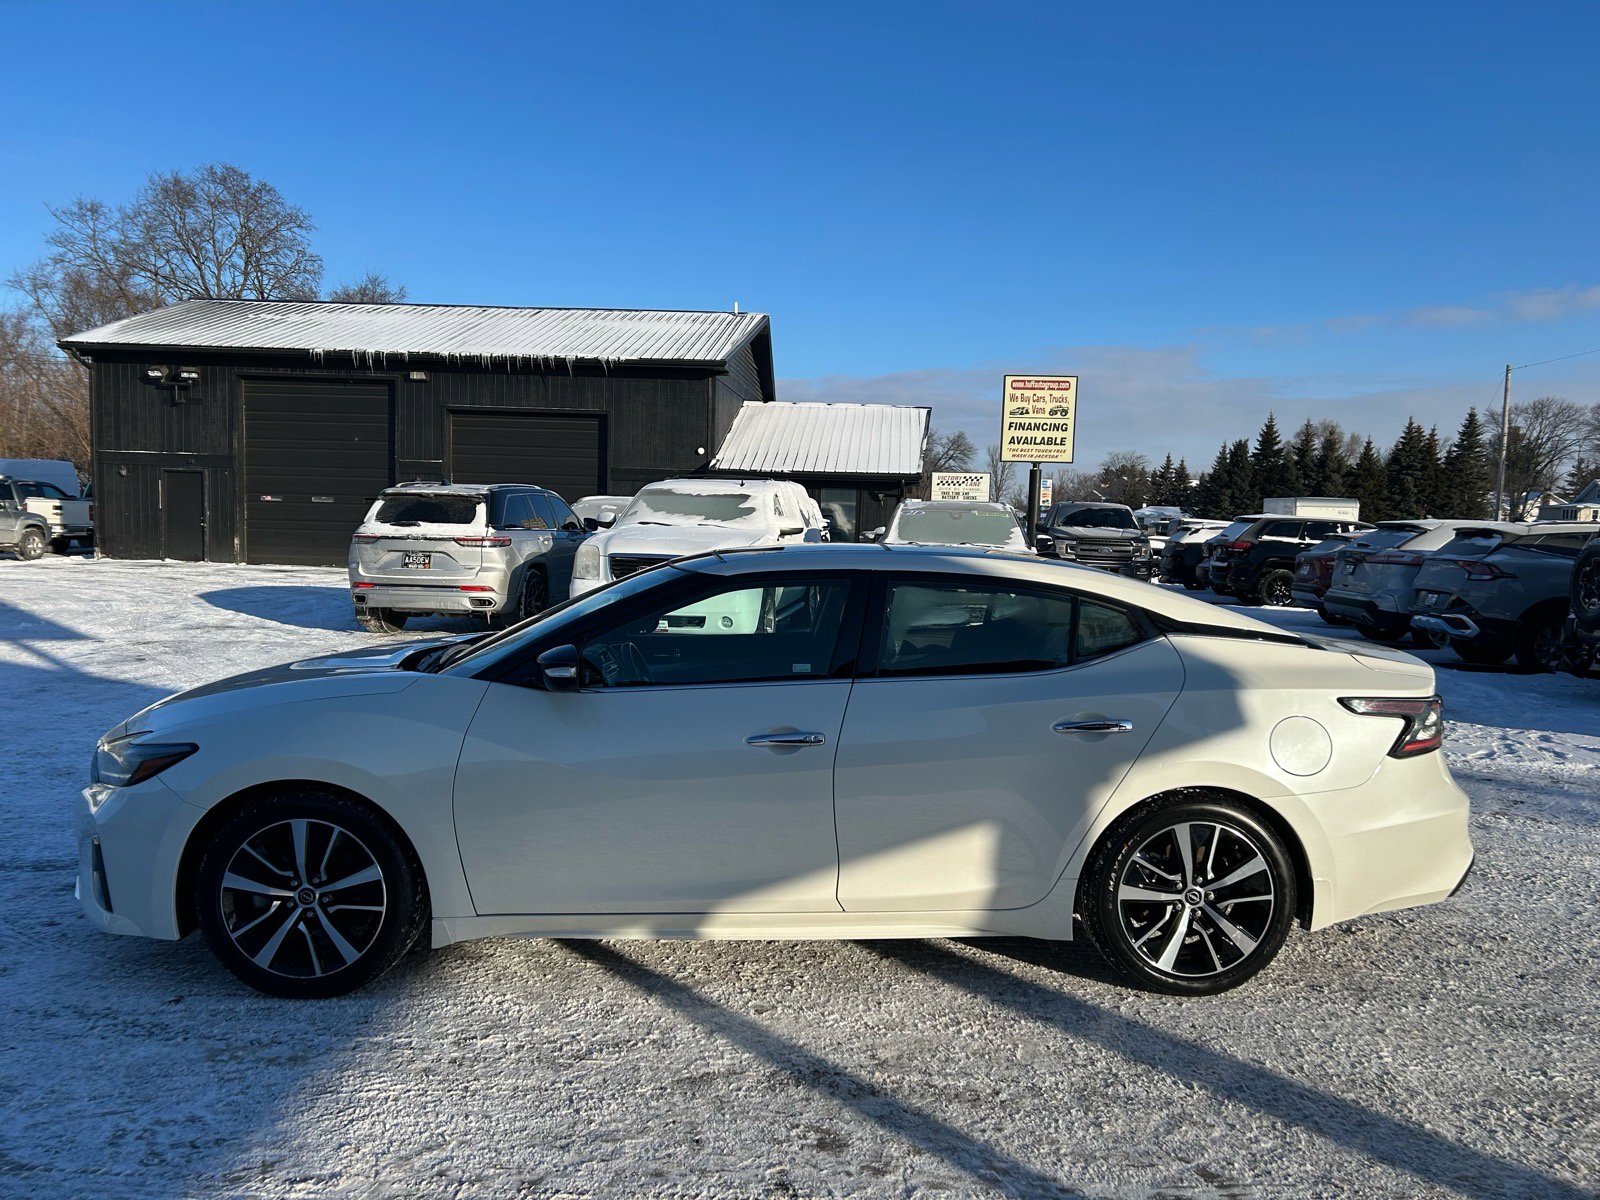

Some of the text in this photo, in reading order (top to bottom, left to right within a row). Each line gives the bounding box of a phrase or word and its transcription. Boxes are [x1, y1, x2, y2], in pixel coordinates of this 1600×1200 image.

[1009, 393, 1070, 405] We Buy Cars, Trucks,
[1031, 404, 1046, 415] Vans
[1008, 422, 1068, 432] FINANCING
[1008, 436, 1067, 446] AVAILABLE
